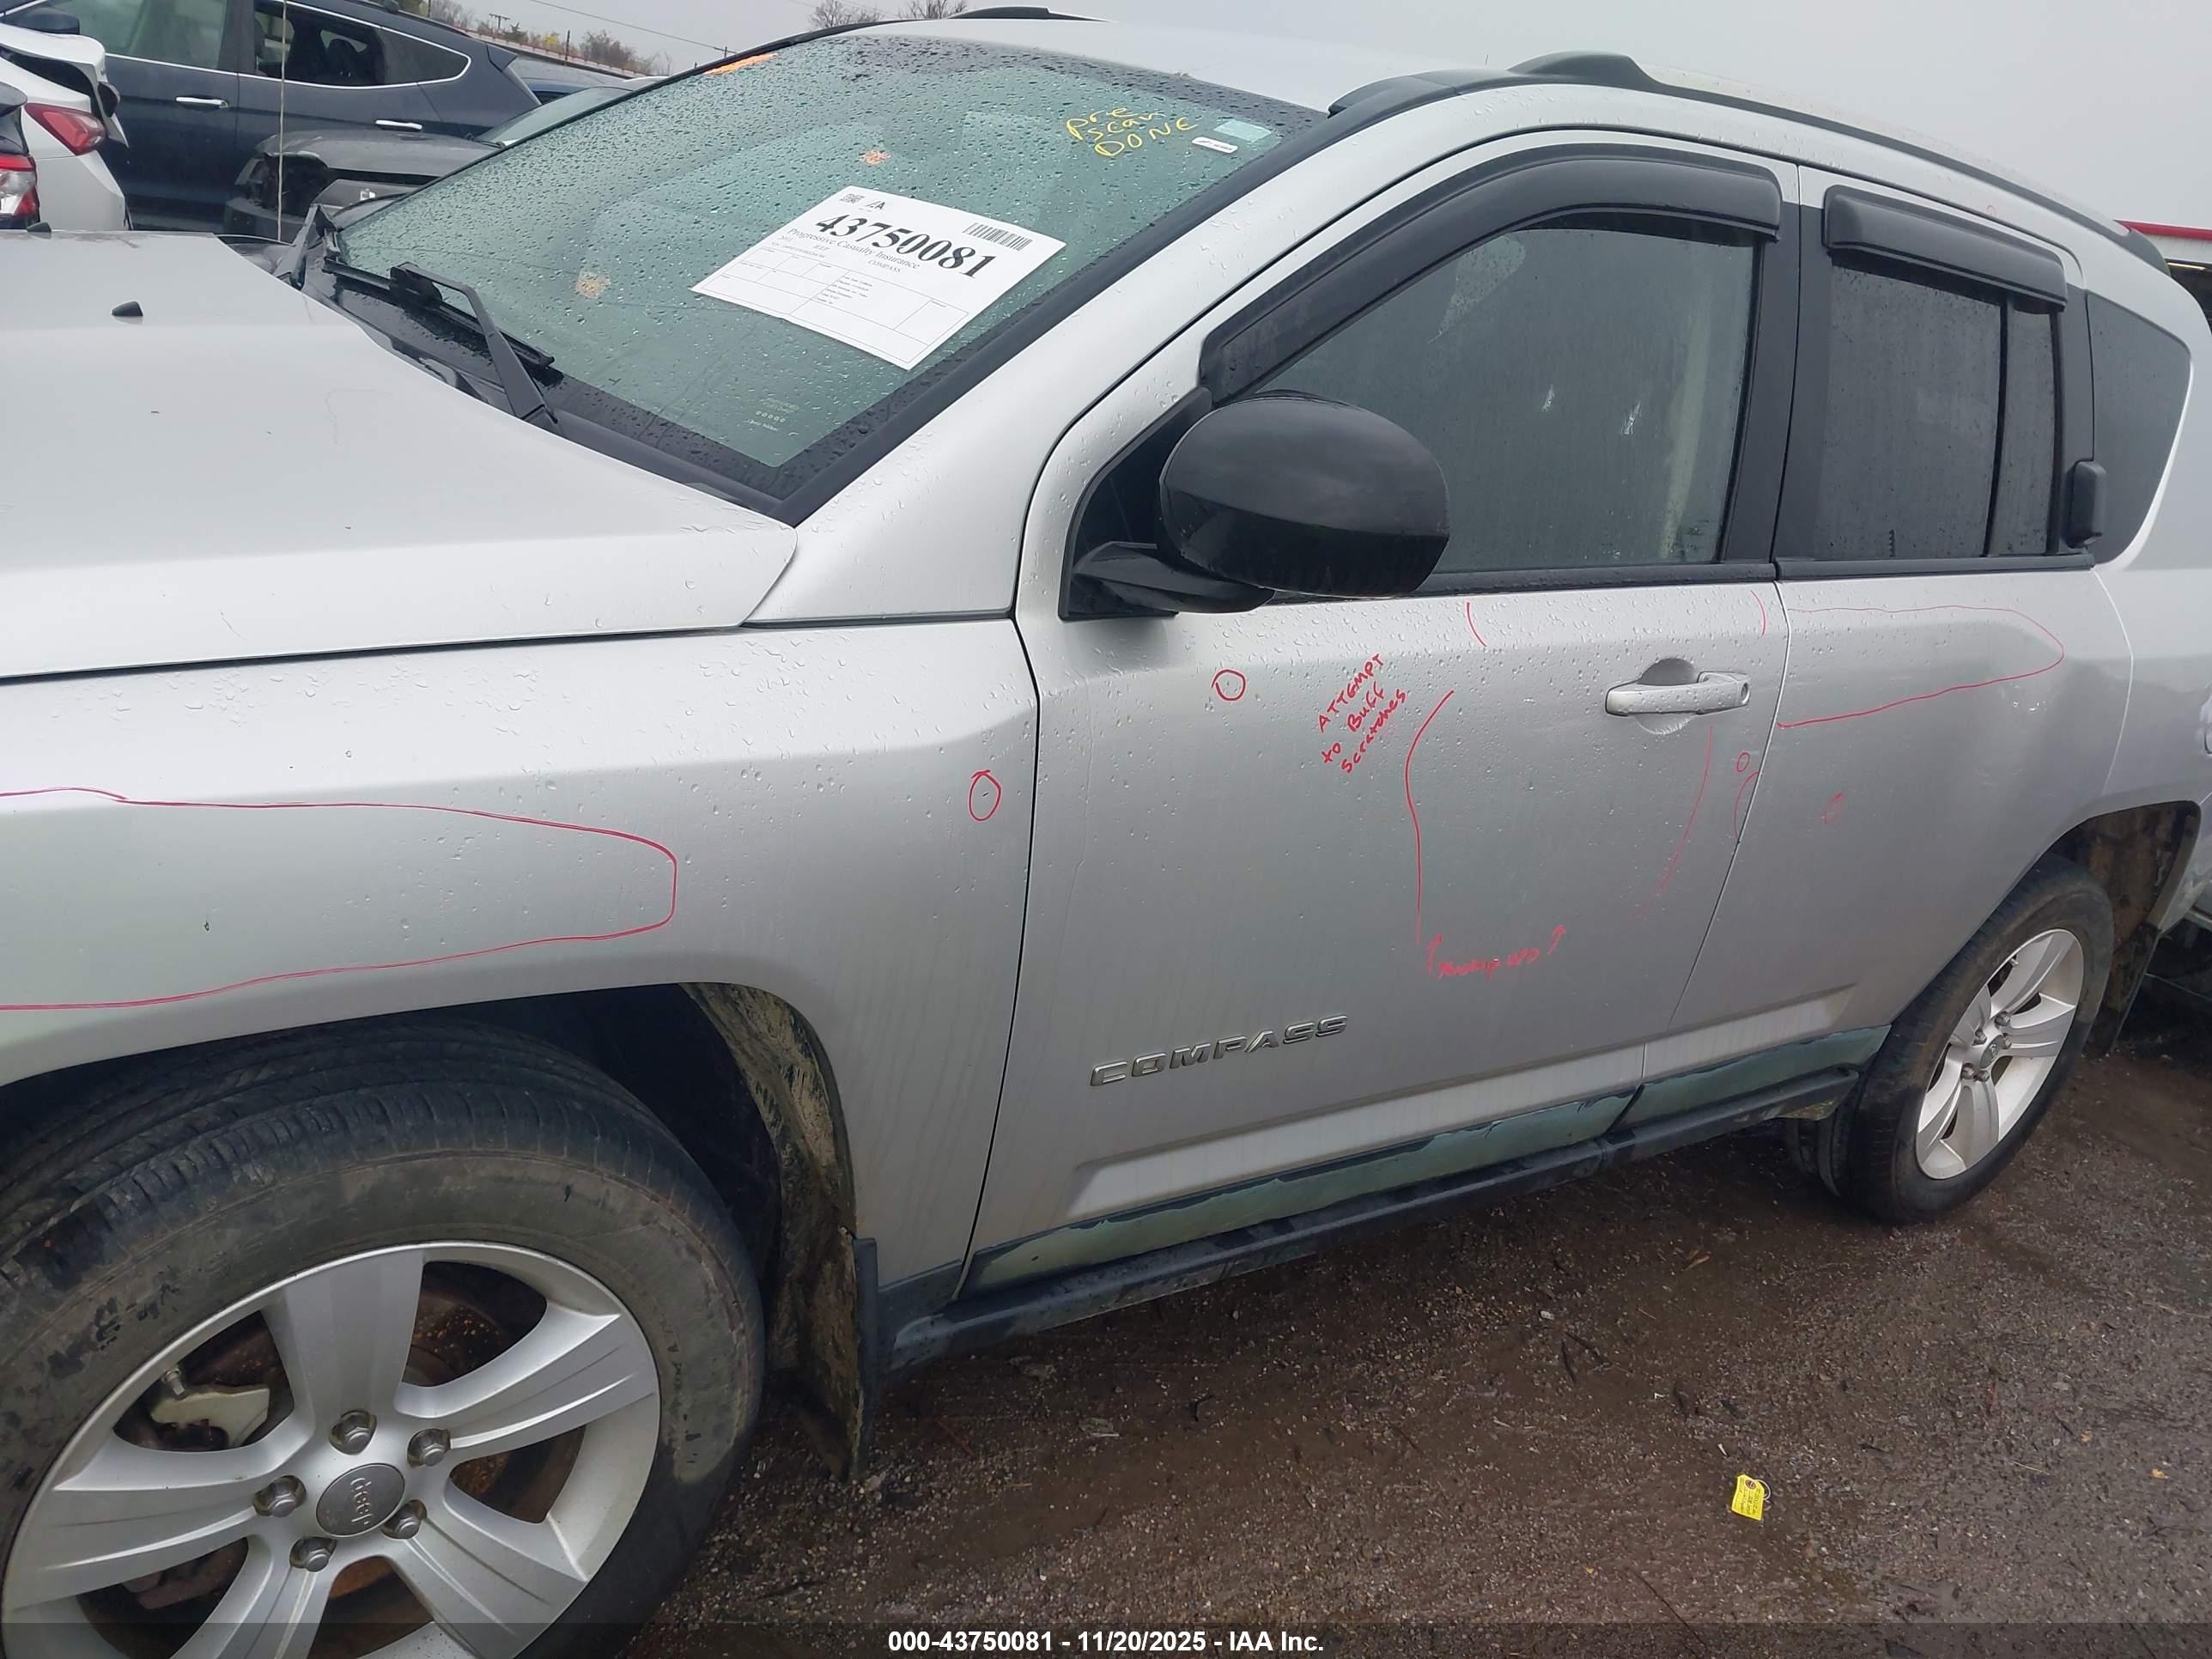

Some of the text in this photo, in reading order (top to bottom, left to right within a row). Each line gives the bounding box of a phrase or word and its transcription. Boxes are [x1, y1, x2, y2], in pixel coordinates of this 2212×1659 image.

[1094, 117, 1199, 156] DONE
[787, 228, 837, 245] Progressive
[836, 240, 873, 256] Casualty
[875, 250, 921, 270] Insurance
[816, 214, 997, 278] 43750081
[1318, 653, 1384, 732] ATTEMPT
[1090, 1015, 1347, 1086] COMPASS
[349, 1477, 373, 1525] Jeep
